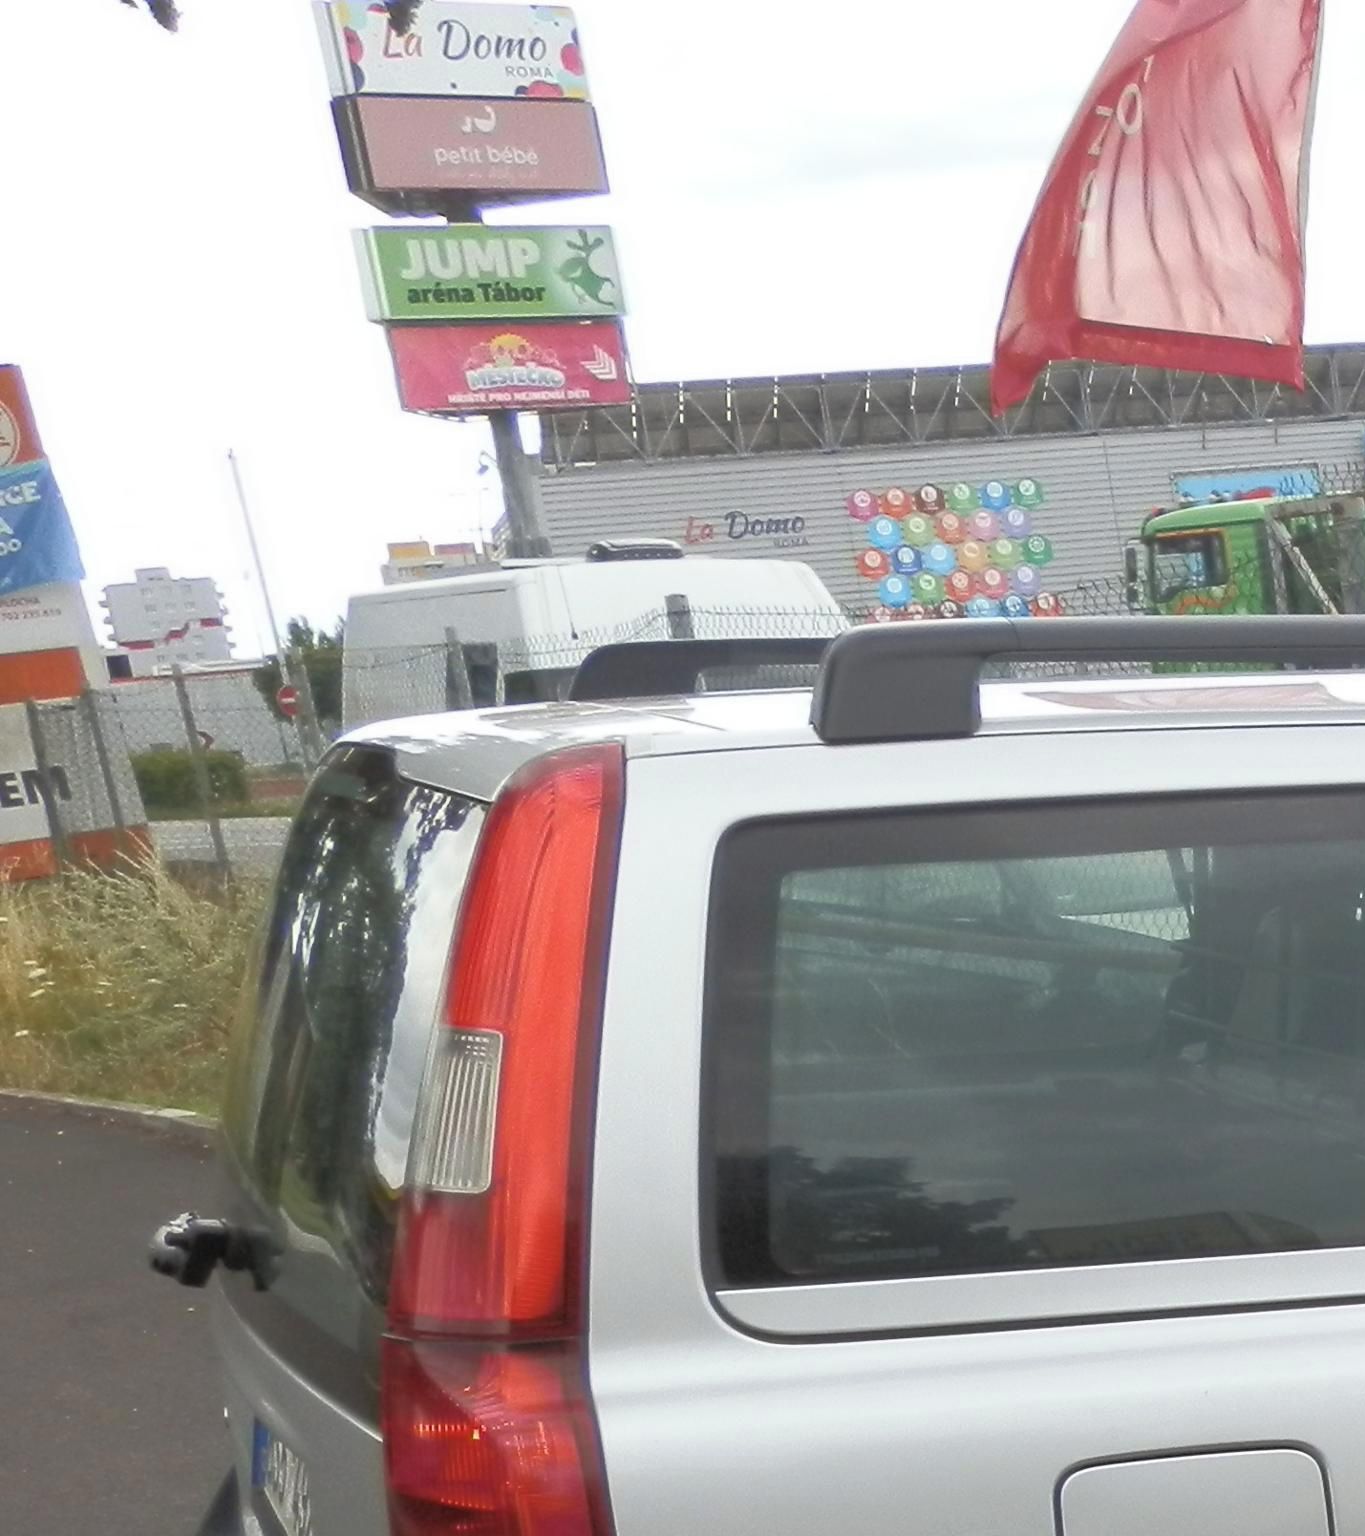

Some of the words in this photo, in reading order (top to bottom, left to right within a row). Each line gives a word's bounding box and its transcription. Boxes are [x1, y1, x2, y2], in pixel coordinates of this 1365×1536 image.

[382, 22, 422, 58] La
[436, 19, 547, 61] Domo
[505, 65, 554, 78] ROMA
[434, 147, 482, 167] petit
[487, 145, 540, 167] bébé
[401, 238, 541, 281] JUMP
[407, 282, 475, 304] aréna
[477, 281, 546, 303] Tábor
[685, 516, 714, 545] La
[724, 510, 805, 539] Domo
